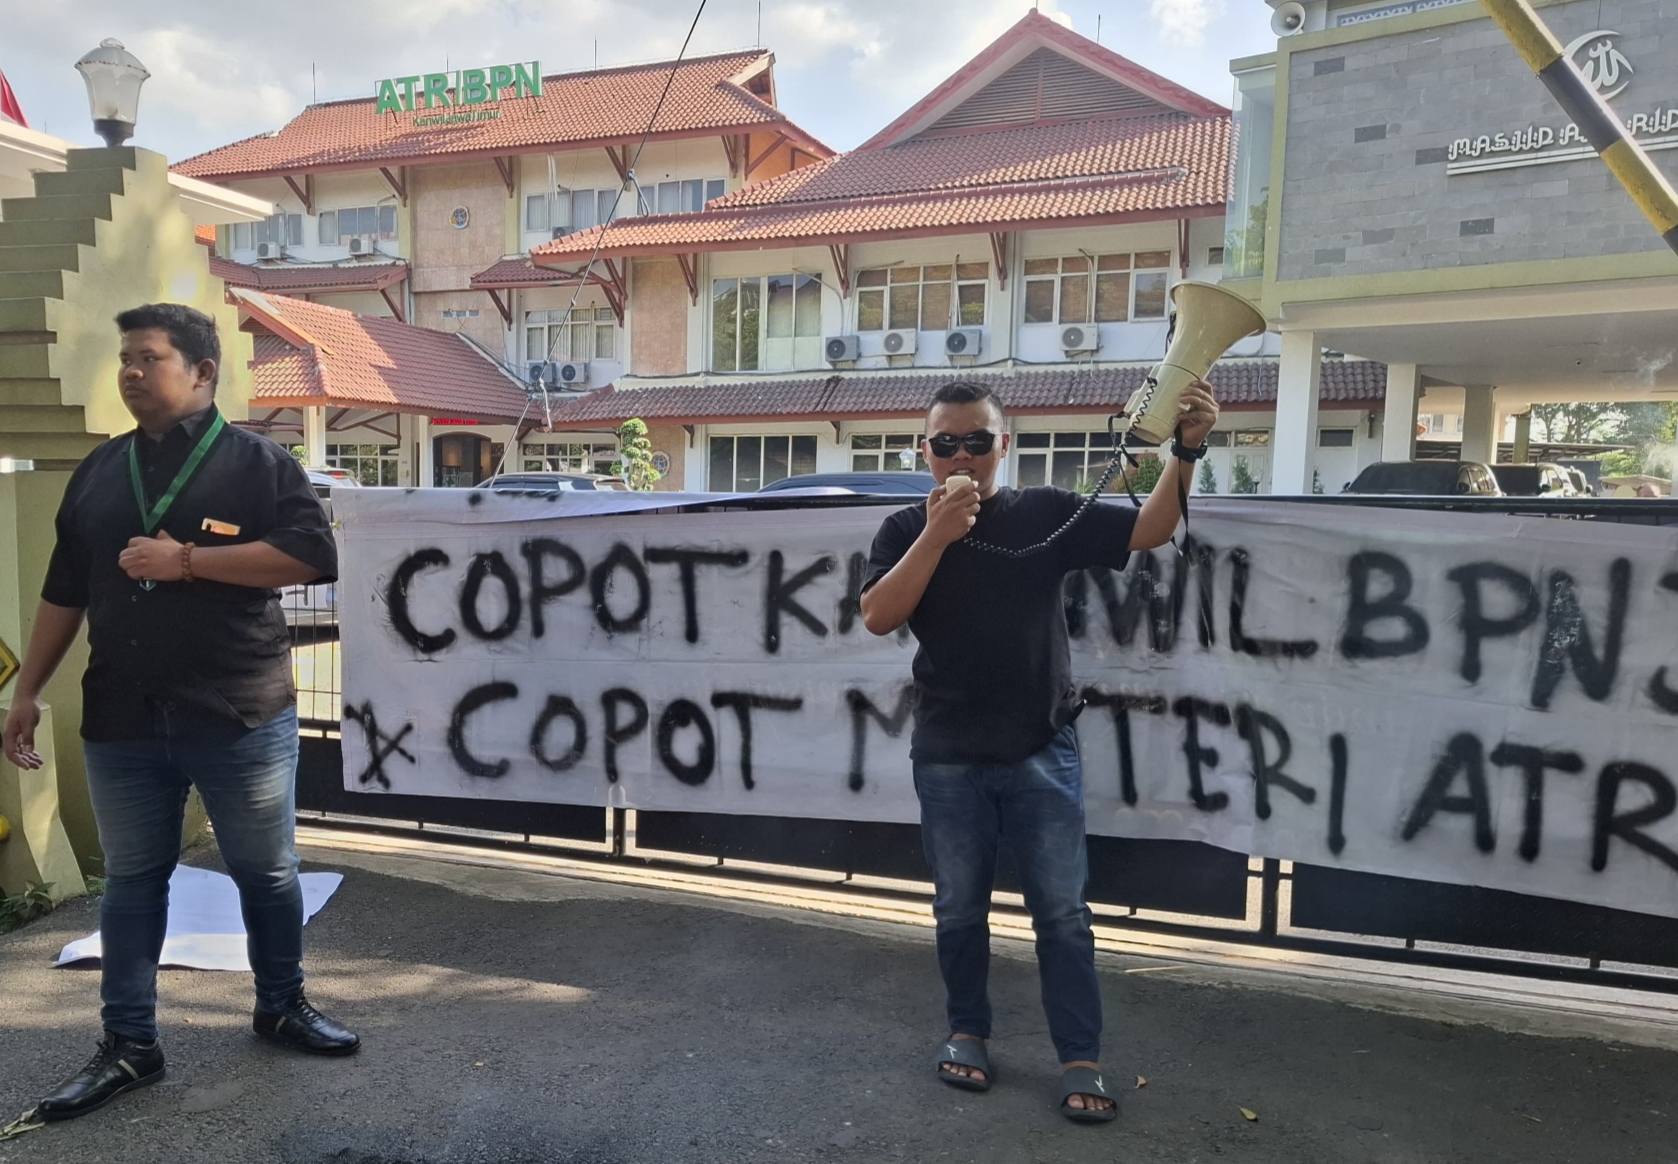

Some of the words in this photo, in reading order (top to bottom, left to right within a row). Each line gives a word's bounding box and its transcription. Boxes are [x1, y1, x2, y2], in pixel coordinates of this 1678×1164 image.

[412, 112, 446, 127] Kanwil
[1448, 125, 1554, 160] MASJID
[386, 537, 750, 655] COPOT
[1340, 550, 1633, 711] BPN
[447, 681, 803, 791] COPOT
[835, 685, 1348, 857] MTERI
[1401, 731, 1678, 873] ATR
